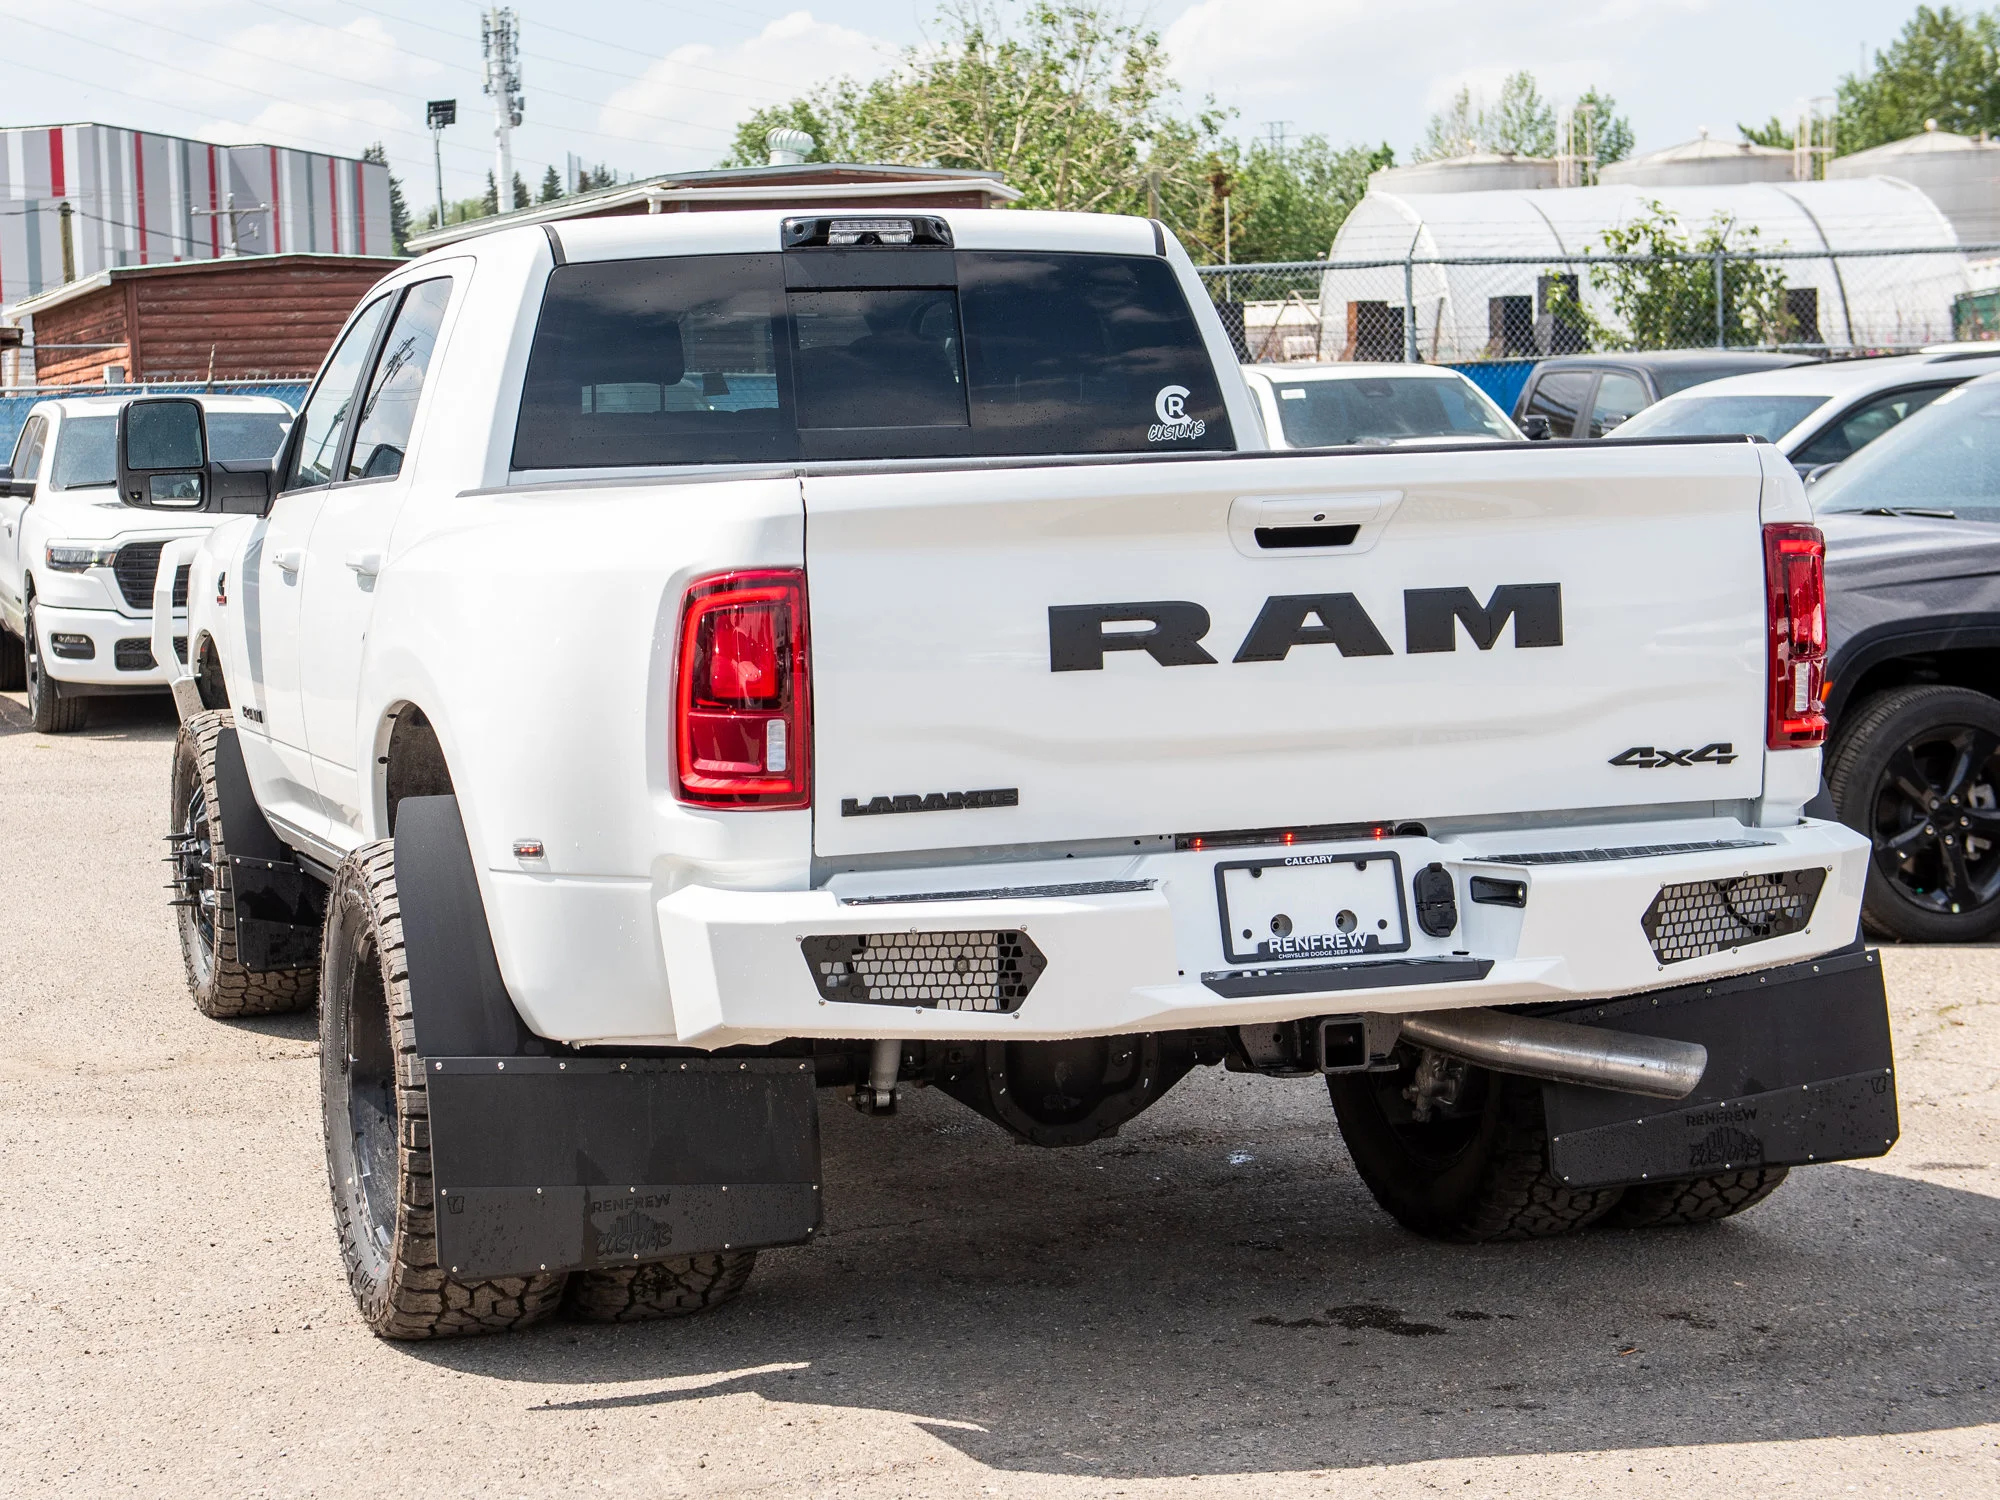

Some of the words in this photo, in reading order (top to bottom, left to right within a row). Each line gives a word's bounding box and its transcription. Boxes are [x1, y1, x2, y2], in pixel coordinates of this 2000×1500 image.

[1148, 420, 1206, 442] CUSTOMS
[1048, 582, 1563, 673] RAM
[1608, 742, 1739, 768] 4x4
[841, 788, 1019, 817] LARAMIE
[1284, 855, 1333, 866] CALGARY
[1268, 932, 1369, 954] RENFREW
[1278, 952, 1310, 960] CHRYSLER
[1686, 1108, 1758, 1127] RENFREW
[591, 1194, 671, 1214] RENFREW
